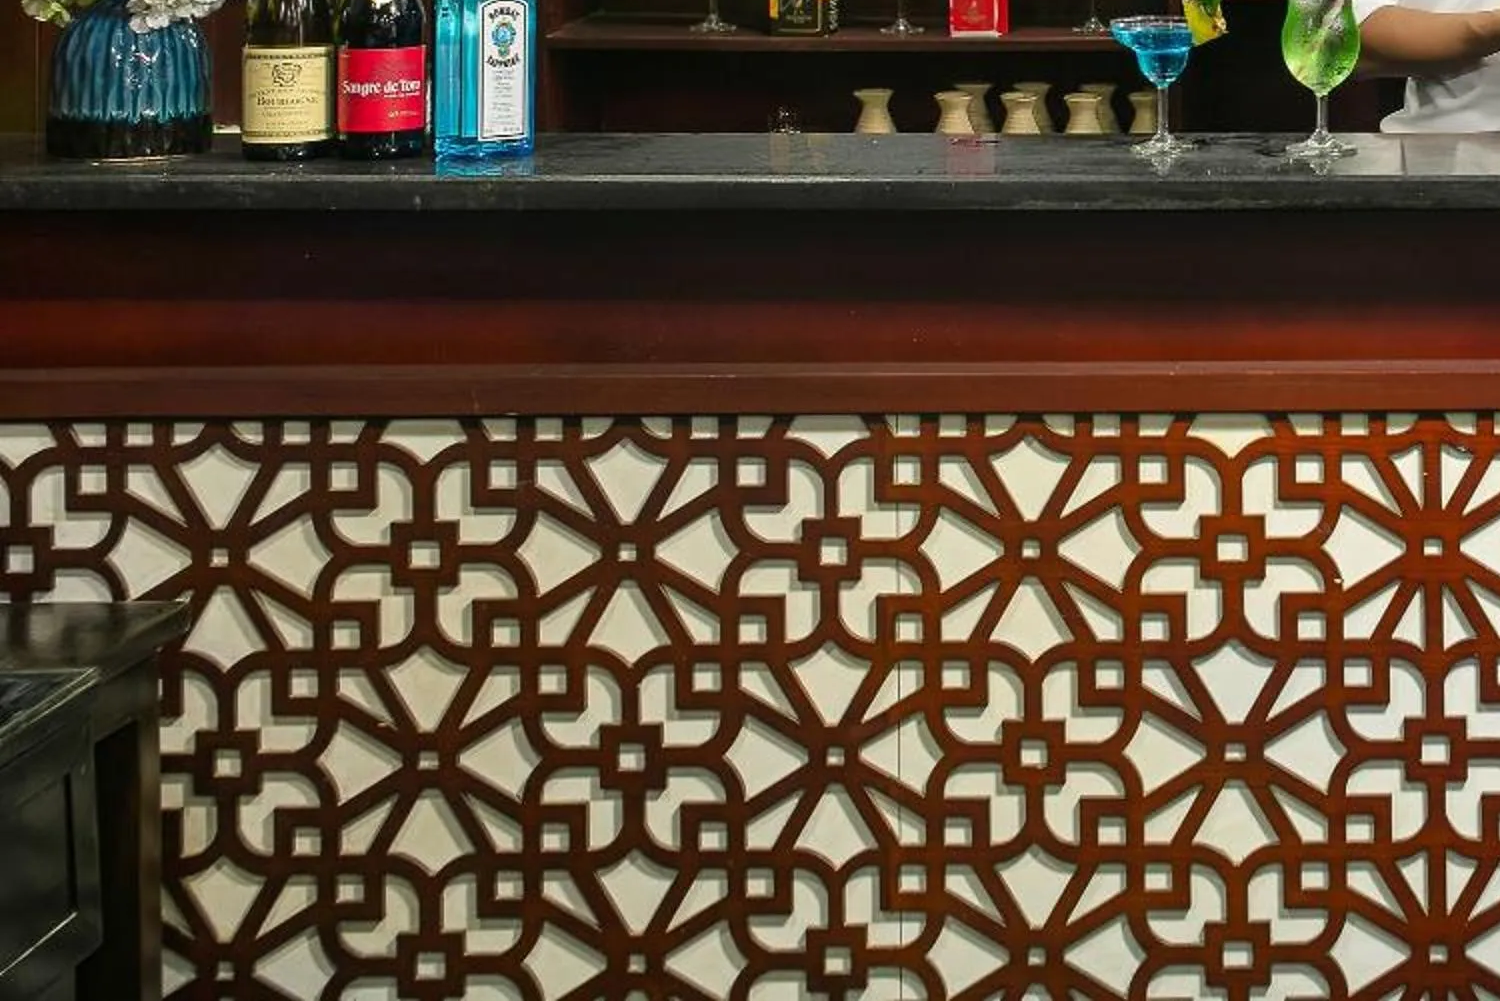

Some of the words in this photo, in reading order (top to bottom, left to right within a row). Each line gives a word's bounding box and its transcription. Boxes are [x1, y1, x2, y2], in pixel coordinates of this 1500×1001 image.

[488, 6, 520, 22] BOMBAY
[342, 80, 381, 97] Sangre
[383, 80, 399, 94] de
